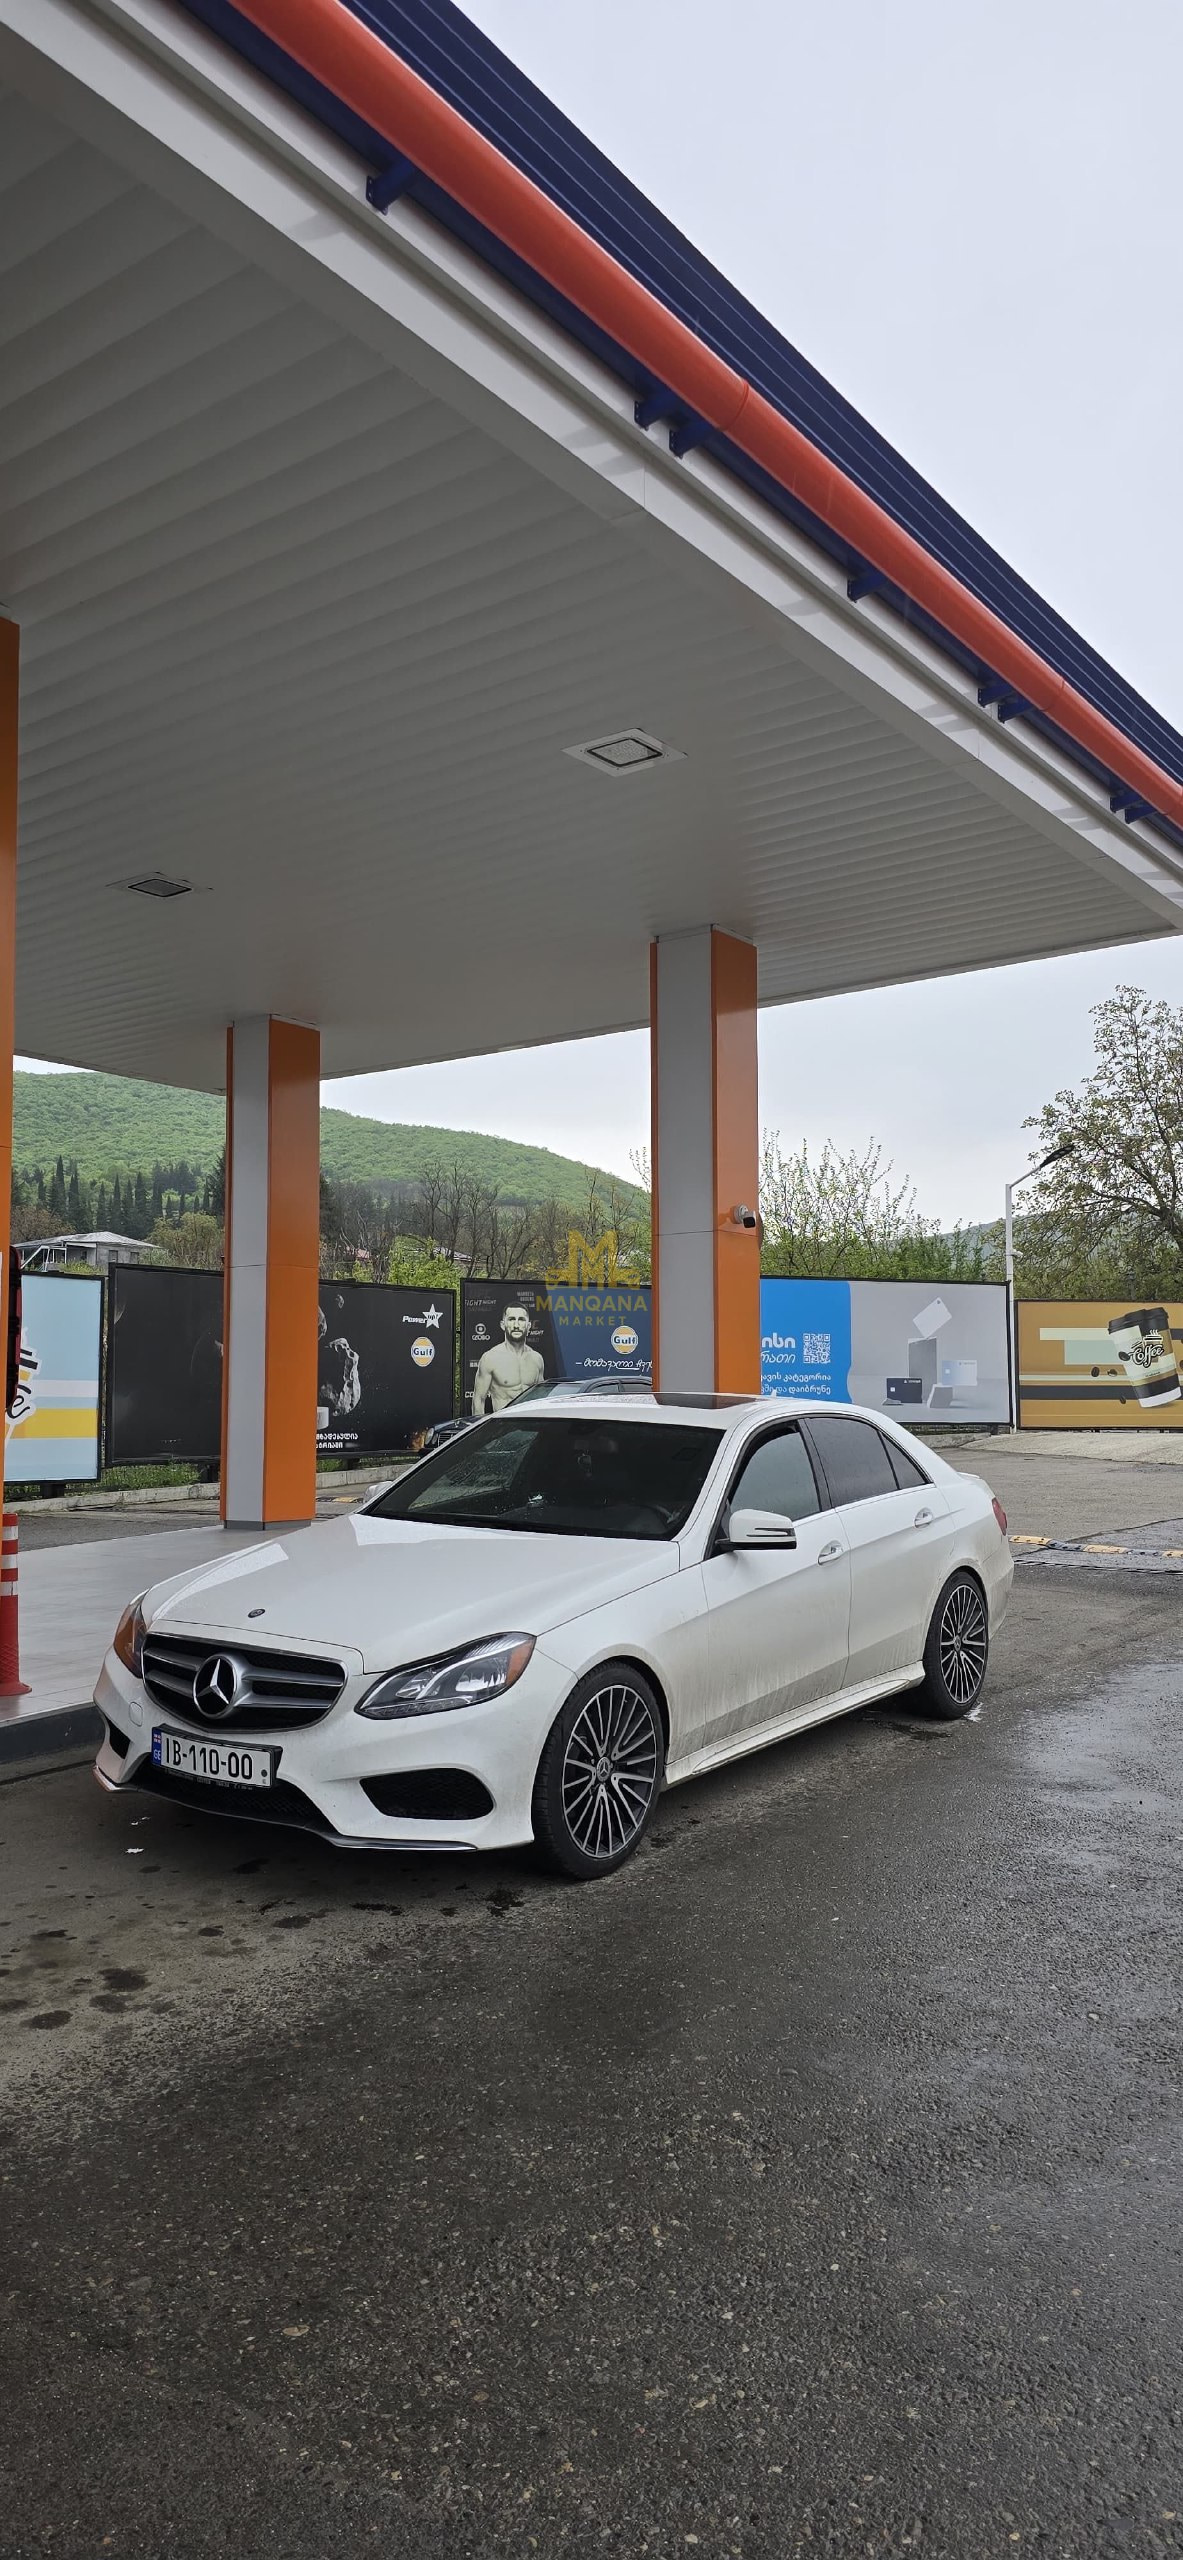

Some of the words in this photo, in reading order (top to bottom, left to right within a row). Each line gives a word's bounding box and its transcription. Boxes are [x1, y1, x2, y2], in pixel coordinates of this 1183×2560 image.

[402, 1315, 427, 1324] Power
[614, 1335, 636, 1344] Gulf
[761, 1332, 796, 1348] ისი
[413, 1347, 433, 1356] Gulf
[761, 1350, 796, 1364] რათი
[1129, 1344, 1164, 1368] Coffee
[761, 1371, 782, 1383] ავის
[783, 1372, 831, 1383] კატეგორია
[788, 1384, 831, 1395] დაიბრუნე
[165, 1737, 253, 1780] IB-110-00
